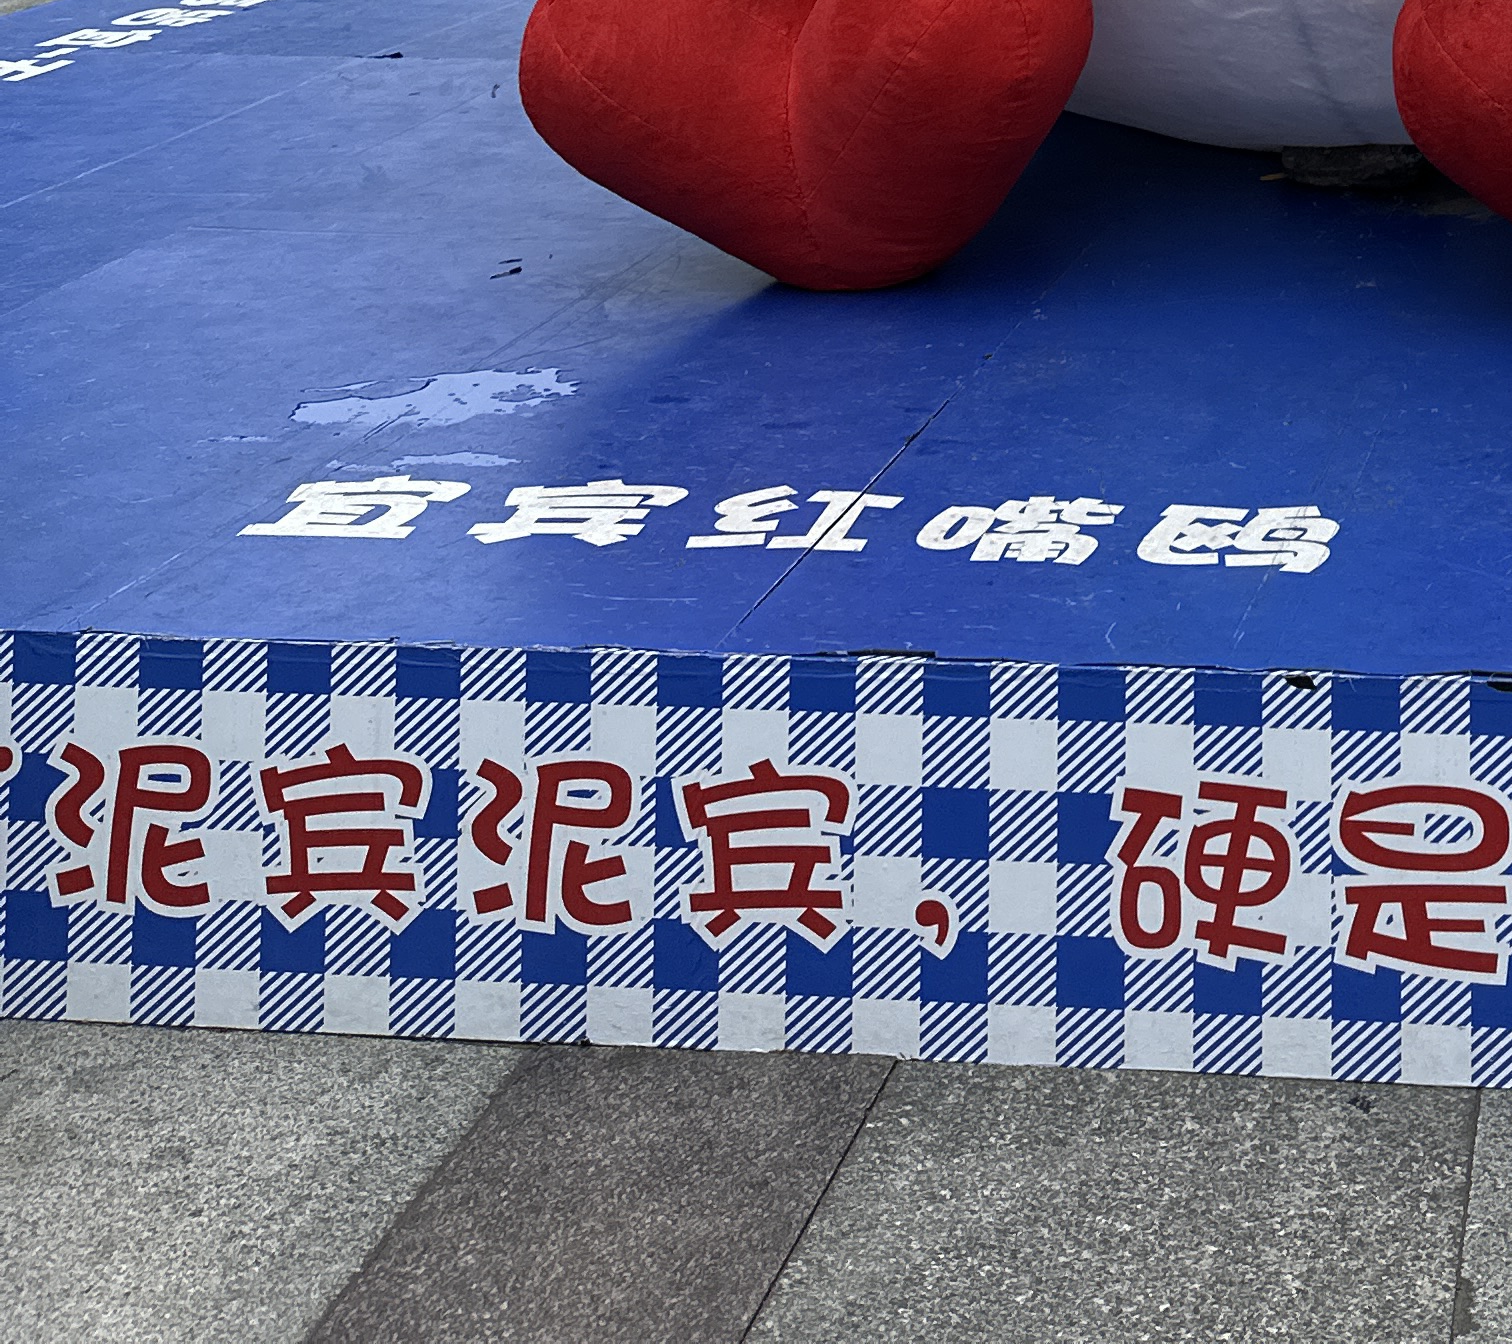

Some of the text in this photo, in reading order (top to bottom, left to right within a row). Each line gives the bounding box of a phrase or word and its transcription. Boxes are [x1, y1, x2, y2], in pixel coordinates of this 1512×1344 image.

[236, 474, 1340, 573] 宜宾红嘴鸥
